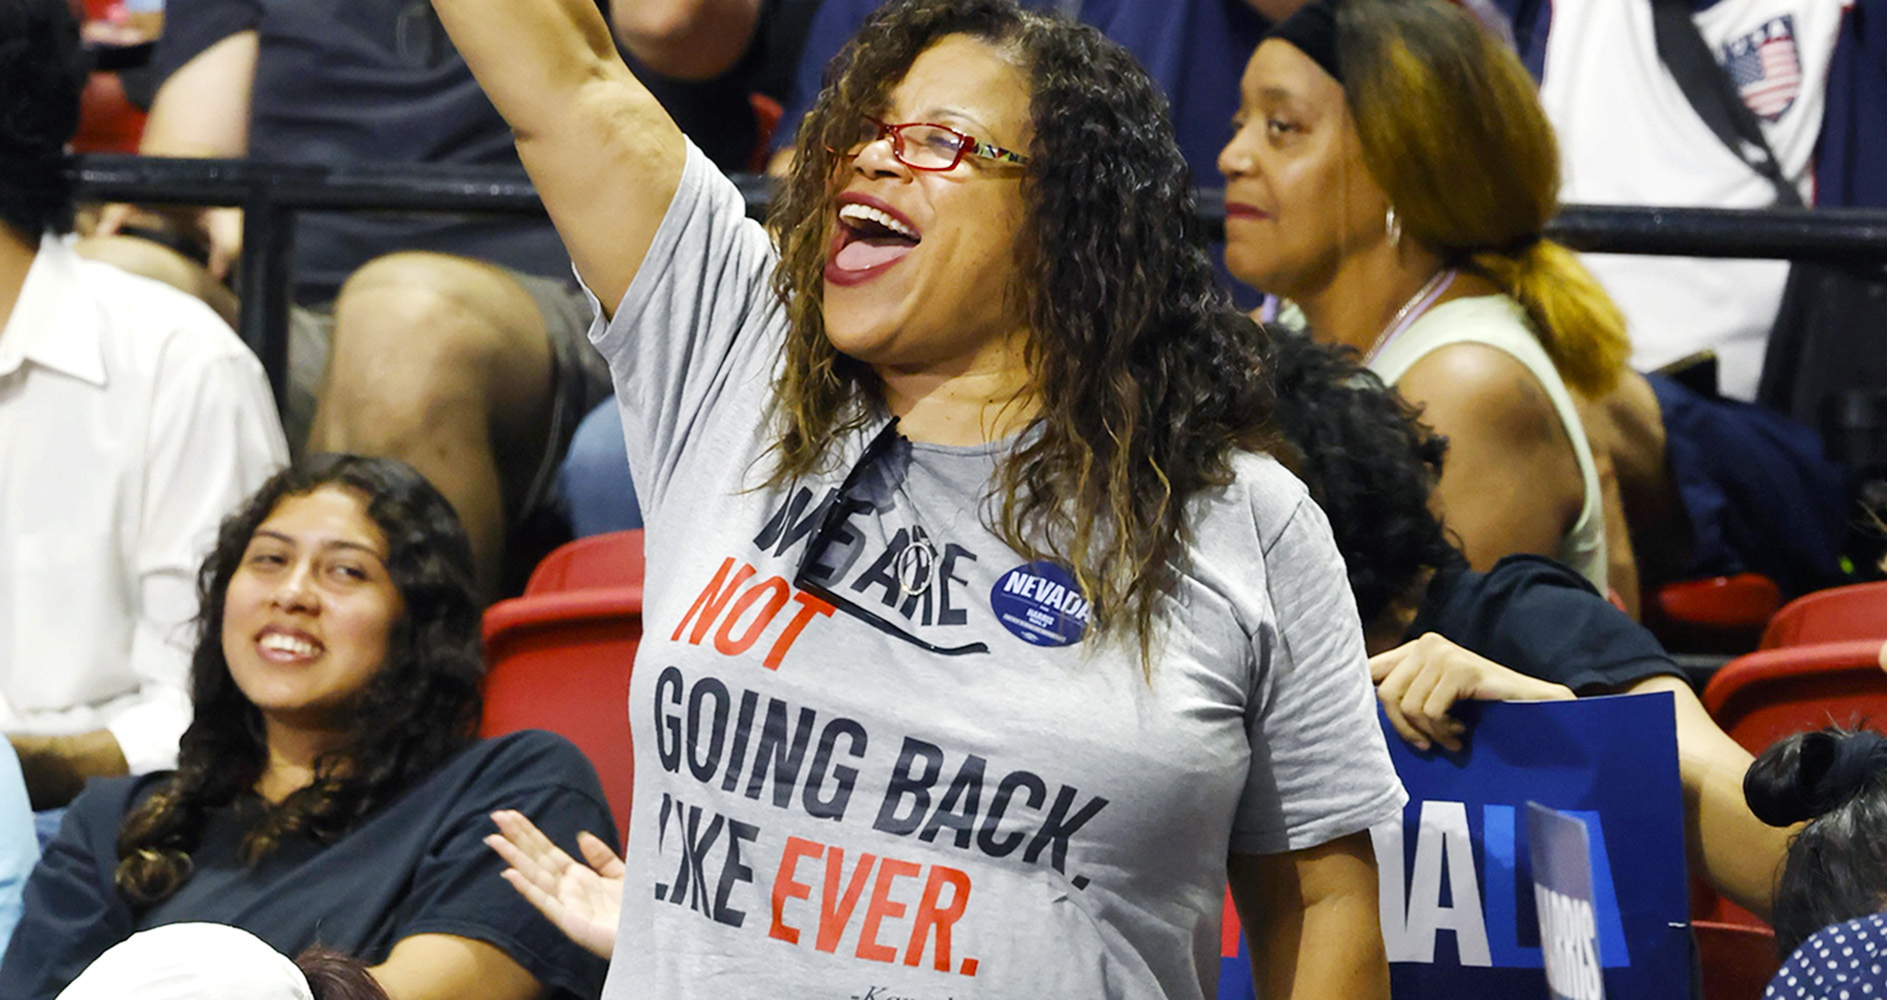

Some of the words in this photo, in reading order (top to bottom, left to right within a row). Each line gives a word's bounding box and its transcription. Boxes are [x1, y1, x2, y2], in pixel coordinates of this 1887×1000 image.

[670, 556, 837, 671] NOT
[1003, 570, 1092, 625] NEVADA
[654, 665, 868, 823] GOING
[872, 735, 1110, 891] BACK.
[768, 835, 980, 977] EVER.
